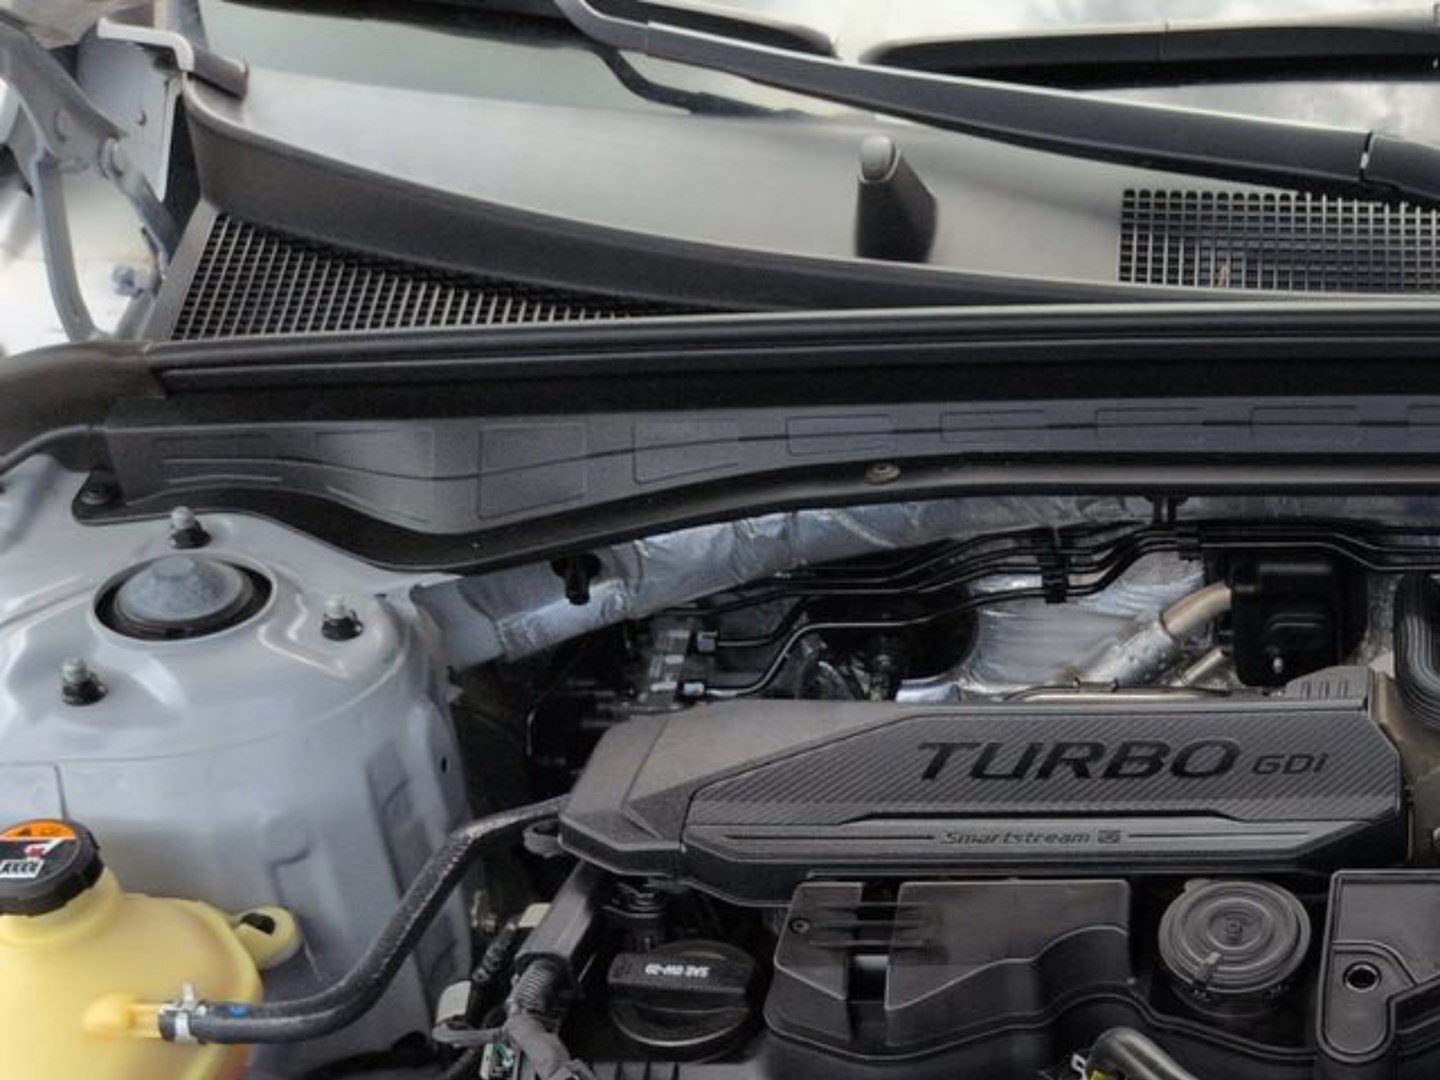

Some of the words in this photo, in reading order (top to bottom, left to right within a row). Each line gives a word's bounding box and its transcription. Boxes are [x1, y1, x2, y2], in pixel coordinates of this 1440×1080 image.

[917, 738, 1242, 781] TURBO
[1251, 751, 1330, 776] GDi
[940, 829, 1091, 845] Smartstream
[685, 964, 710, 977] SAE
